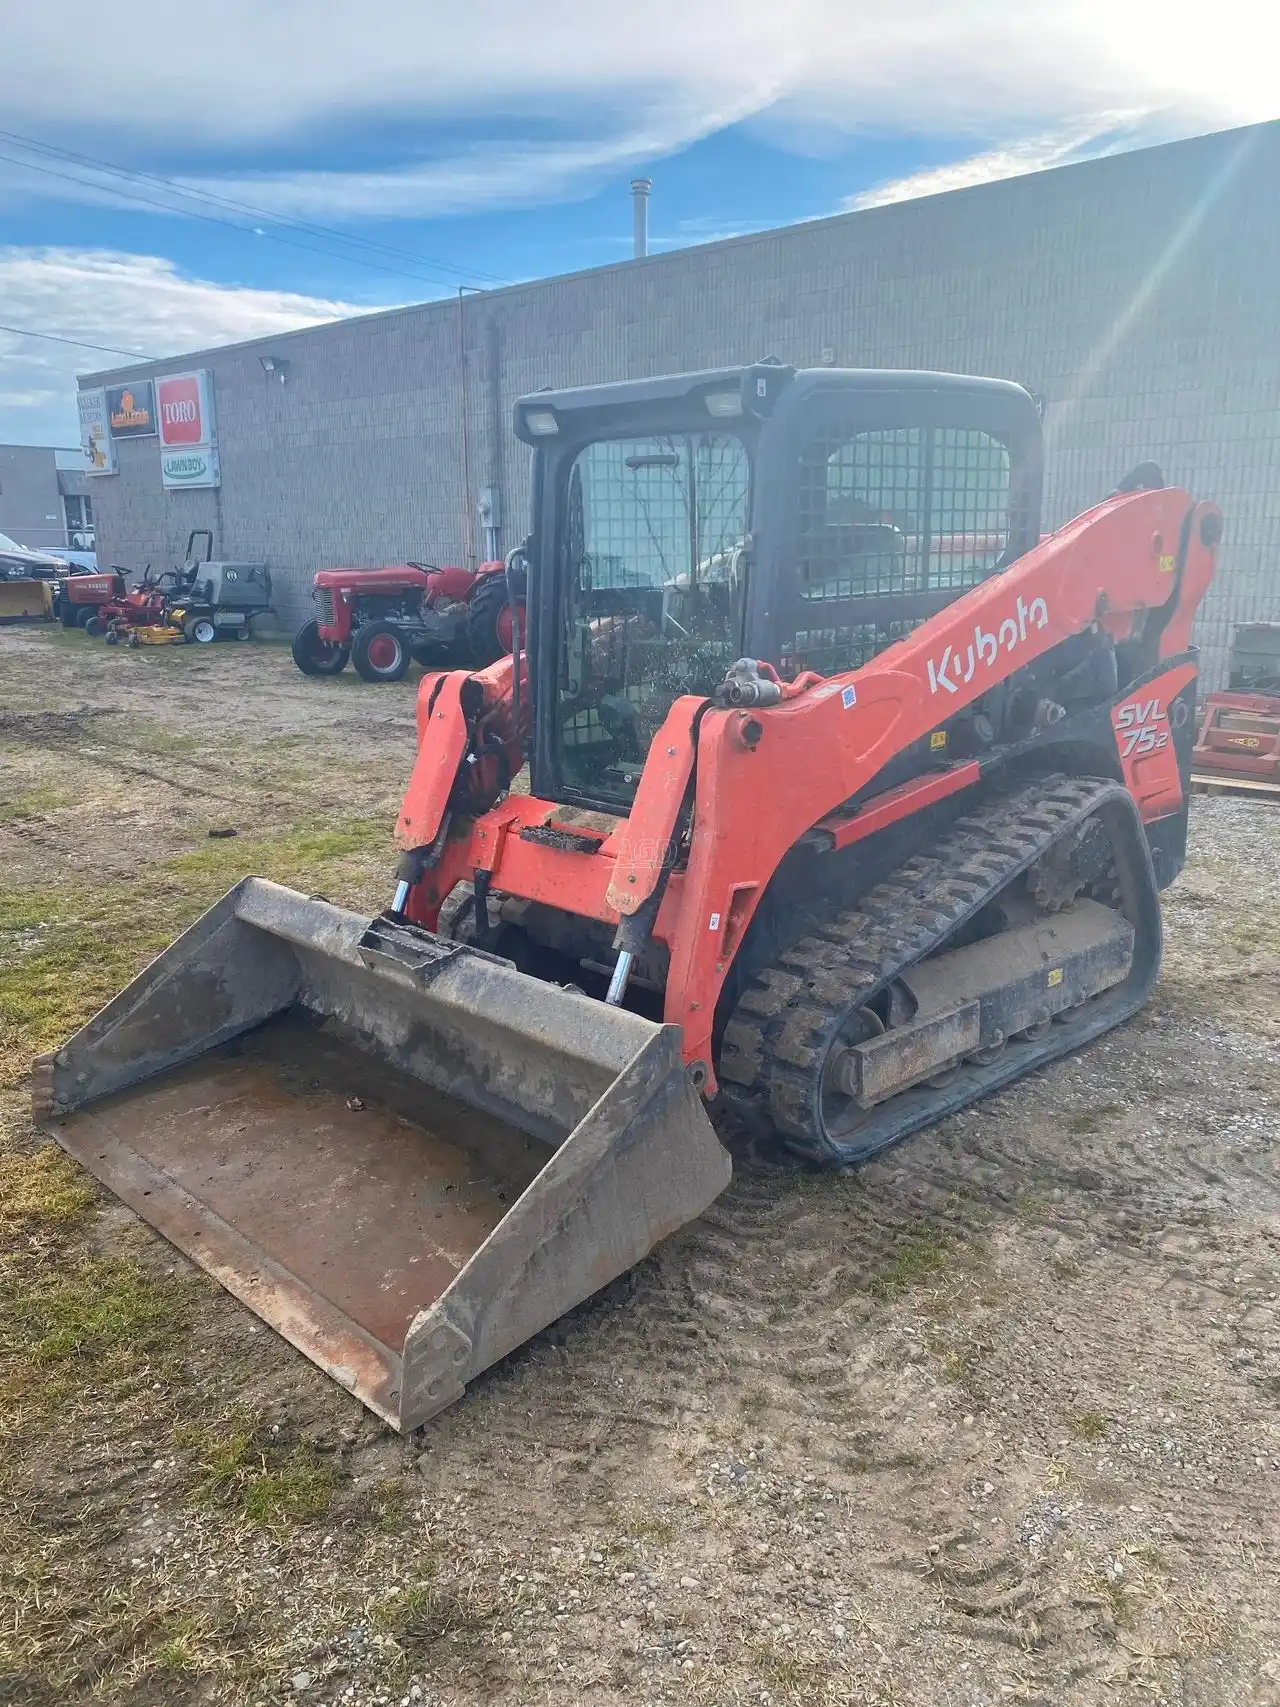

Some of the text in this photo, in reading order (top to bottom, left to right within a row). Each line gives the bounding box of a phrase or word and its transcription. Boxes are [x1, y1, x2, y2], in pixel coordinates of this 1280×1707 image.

[162, 400, 196, 424] TORO
[927, 595, 1048, 694] Kubota
[1115, 698, 1167, 730] SVL
